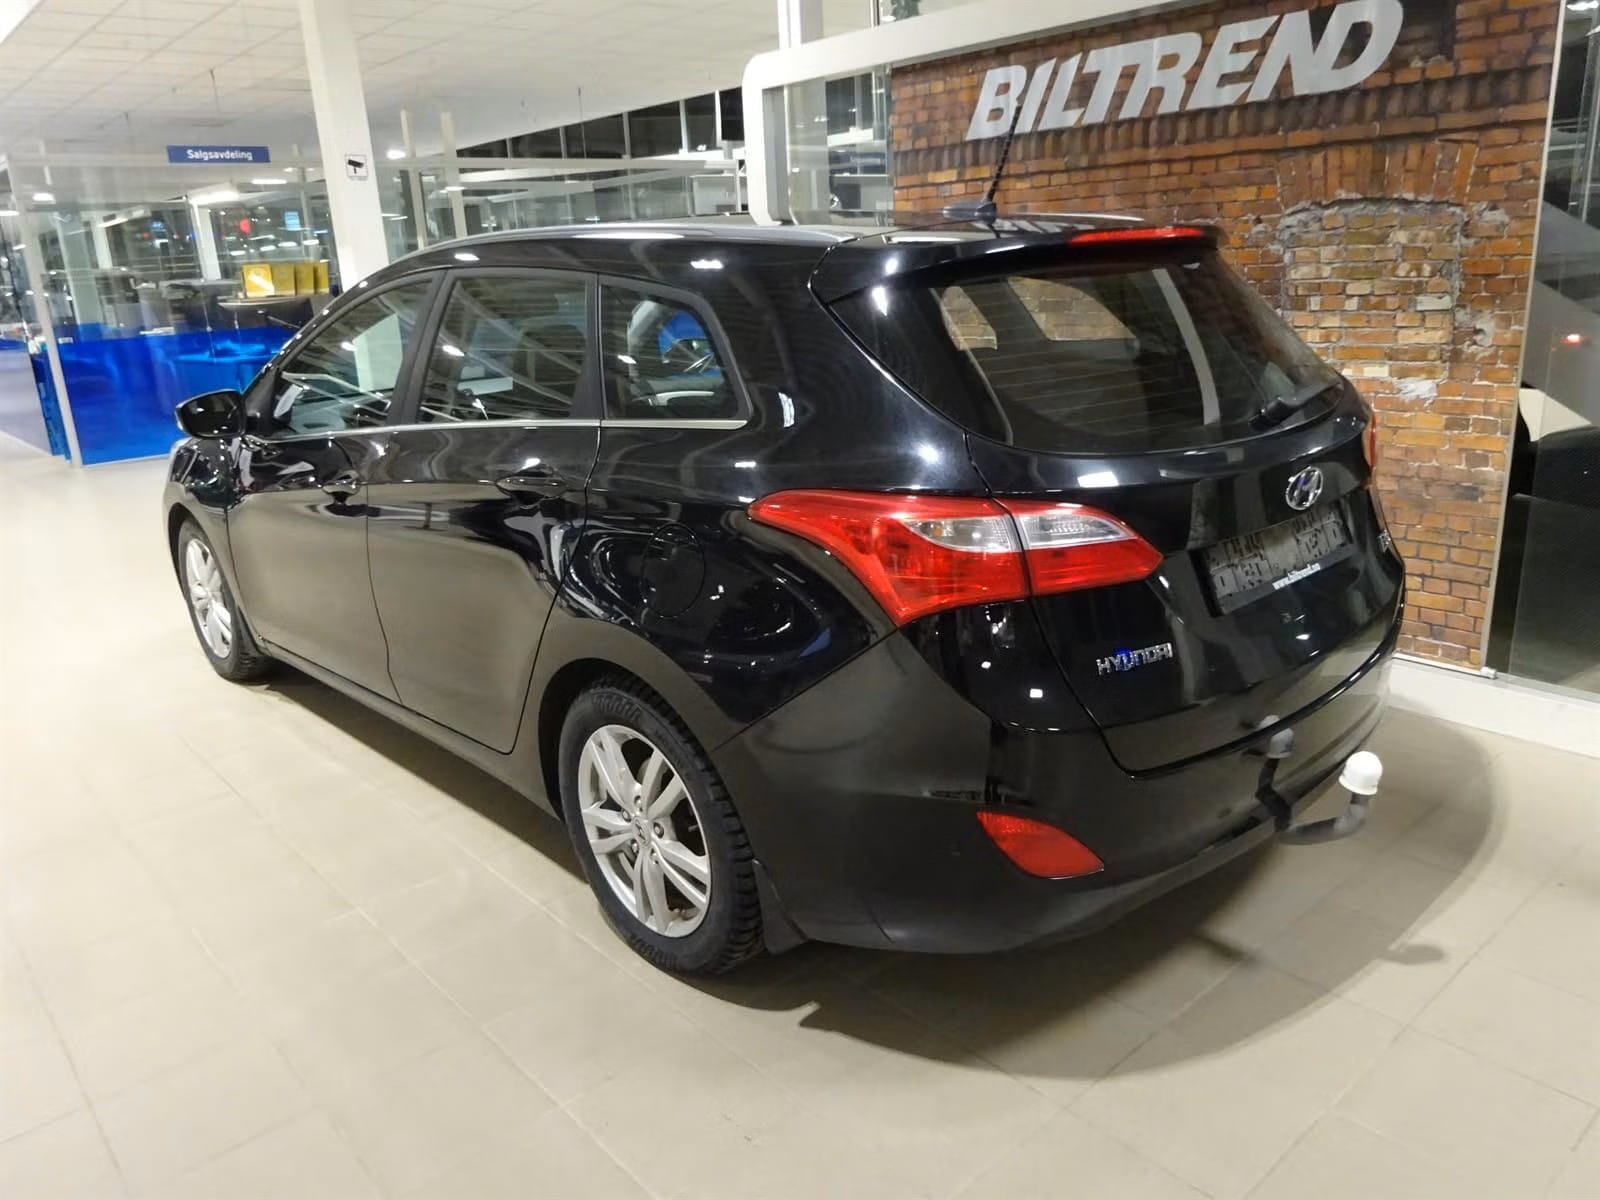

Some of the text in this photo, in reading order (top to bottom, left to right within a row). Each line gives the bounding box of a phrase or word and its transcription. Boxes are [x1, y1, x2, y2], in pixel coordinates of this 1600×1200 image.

[965, 0, 1404, 141] BILTREND
[186, 149, 253, 161] Salgsavdeling
[1096, 643, 1173, 675] HYUNDAI
